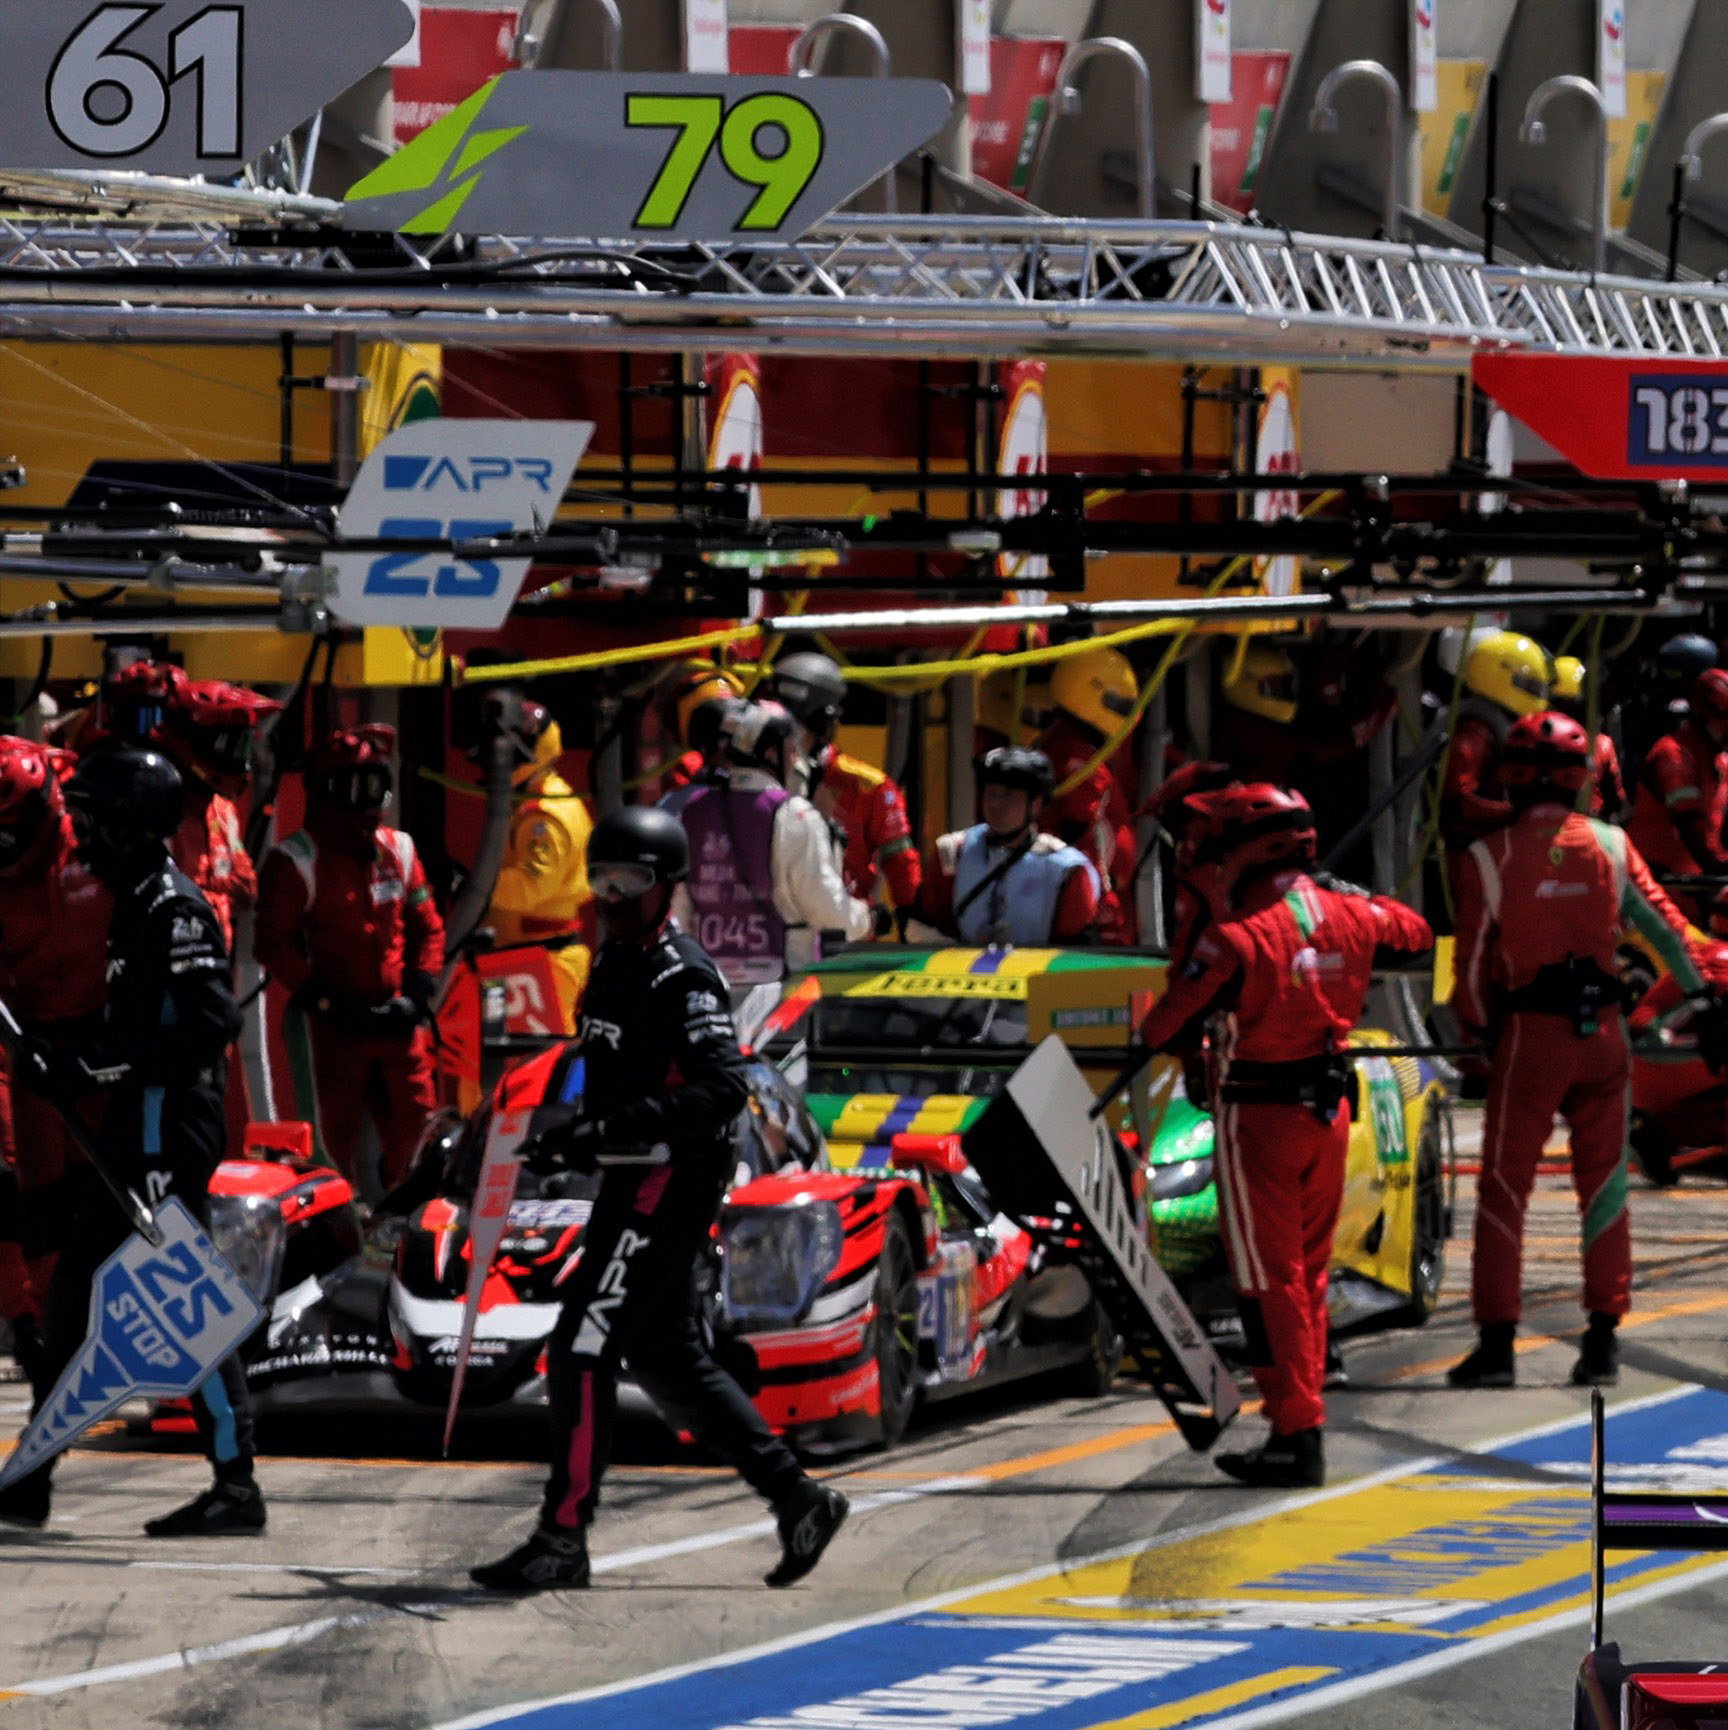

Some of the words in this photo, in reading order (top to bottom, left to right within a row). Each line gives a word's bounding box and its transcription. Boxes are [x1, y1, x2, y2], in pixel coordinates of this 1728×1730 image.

[46, 3, 245, 158] 61
[624, 91, 824, 232] 79
[418, 457, 553, 492] APR
[364, 518, 514, 597] 25
[106, 1291, 181, 1368] STOP
[133, 1240, 234, 1341] 25
